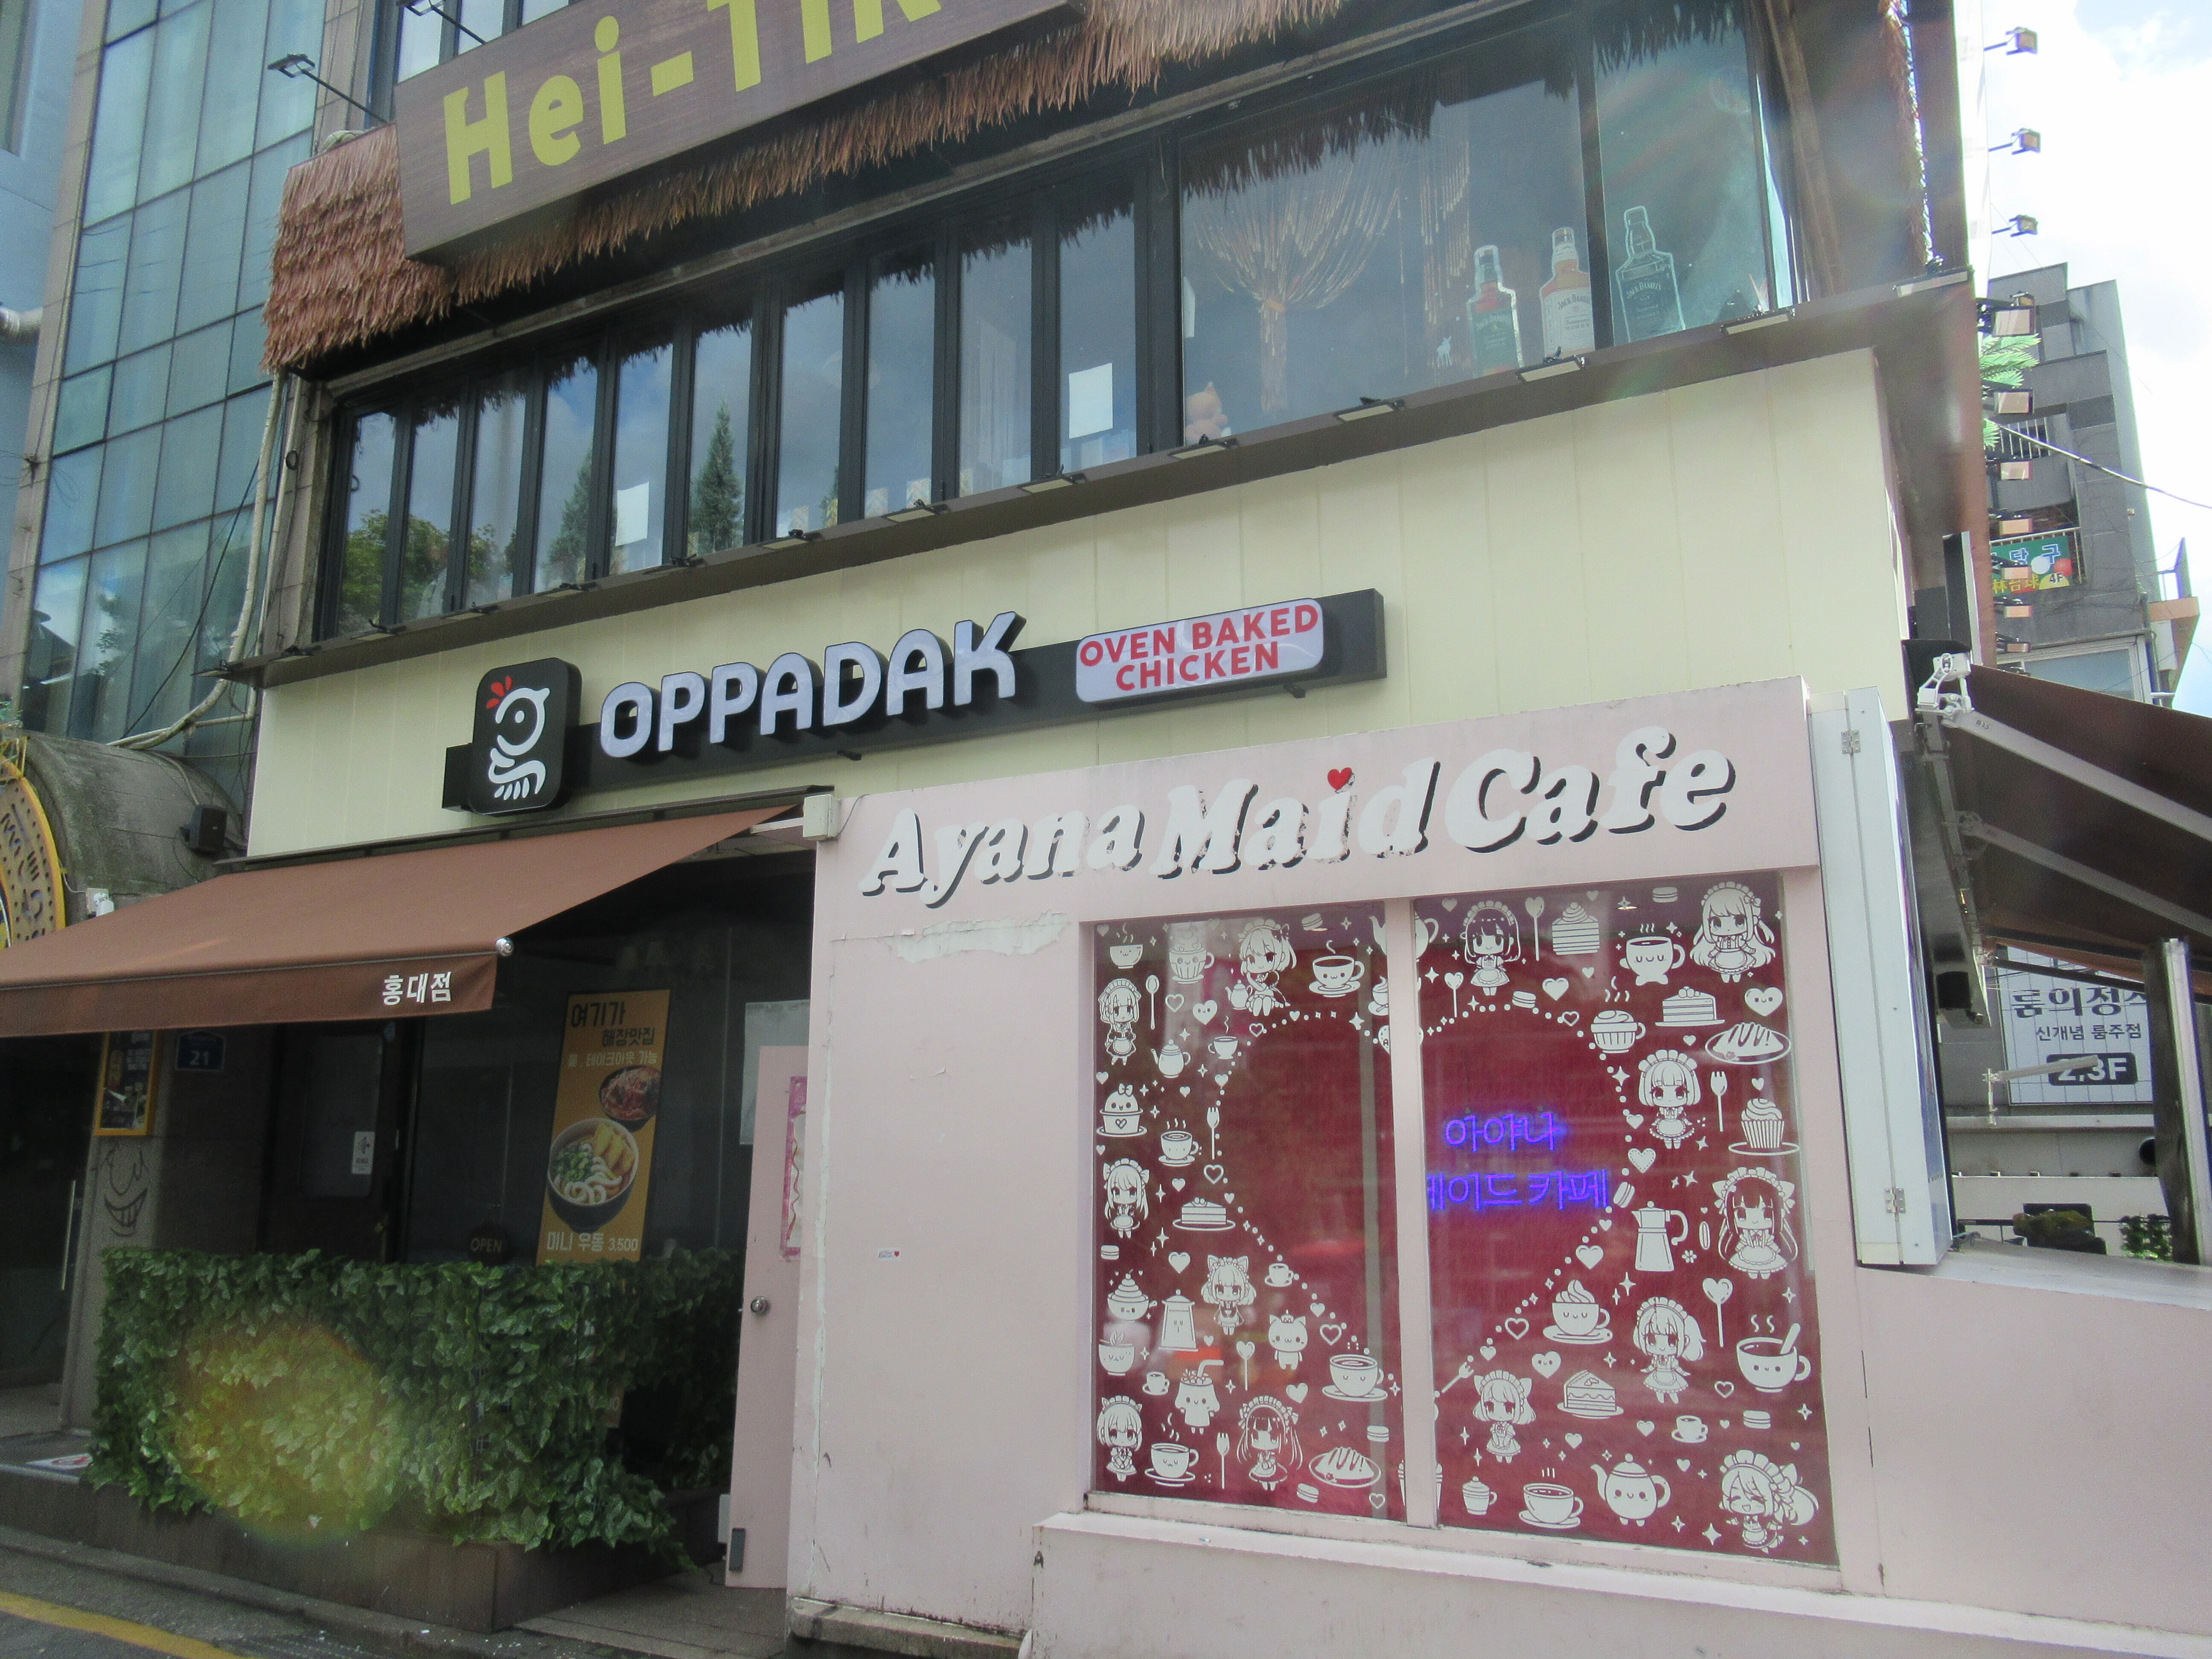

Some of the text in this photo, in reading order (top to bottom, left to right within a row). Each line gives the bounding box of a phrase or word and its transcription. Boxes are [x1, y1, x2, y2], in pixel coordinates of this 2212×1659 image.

[2049, 572, 2066, 584] 4F
[1080, 604, 1319, 667] OVEN BAKED
[1115, 641, 1279, 691] CHICKEN
[601, 610, 1026, 759] OPPADAK
[859, 725, 1736, 909] Ayana Maid Cafe
[382, 971, 452, 1005] 홍대점
[571, 1001, 626, 1028] 여기가
[602, 1027, 655, 1047] 해장맛집
[2036, 1023, 2142, 1041] 신개념 룸주점
[189, 1050, 210, 1066] 21
[639, 1050, 658, 1065] 가능
[1444, 1112, 1567, 1152] 아야나
[1527, 1168, 1610, 1210] 카페
[471, 1237, 502, 1254] OPEN
[547, 1232, 638, 1252] 미니 우동 3,500
